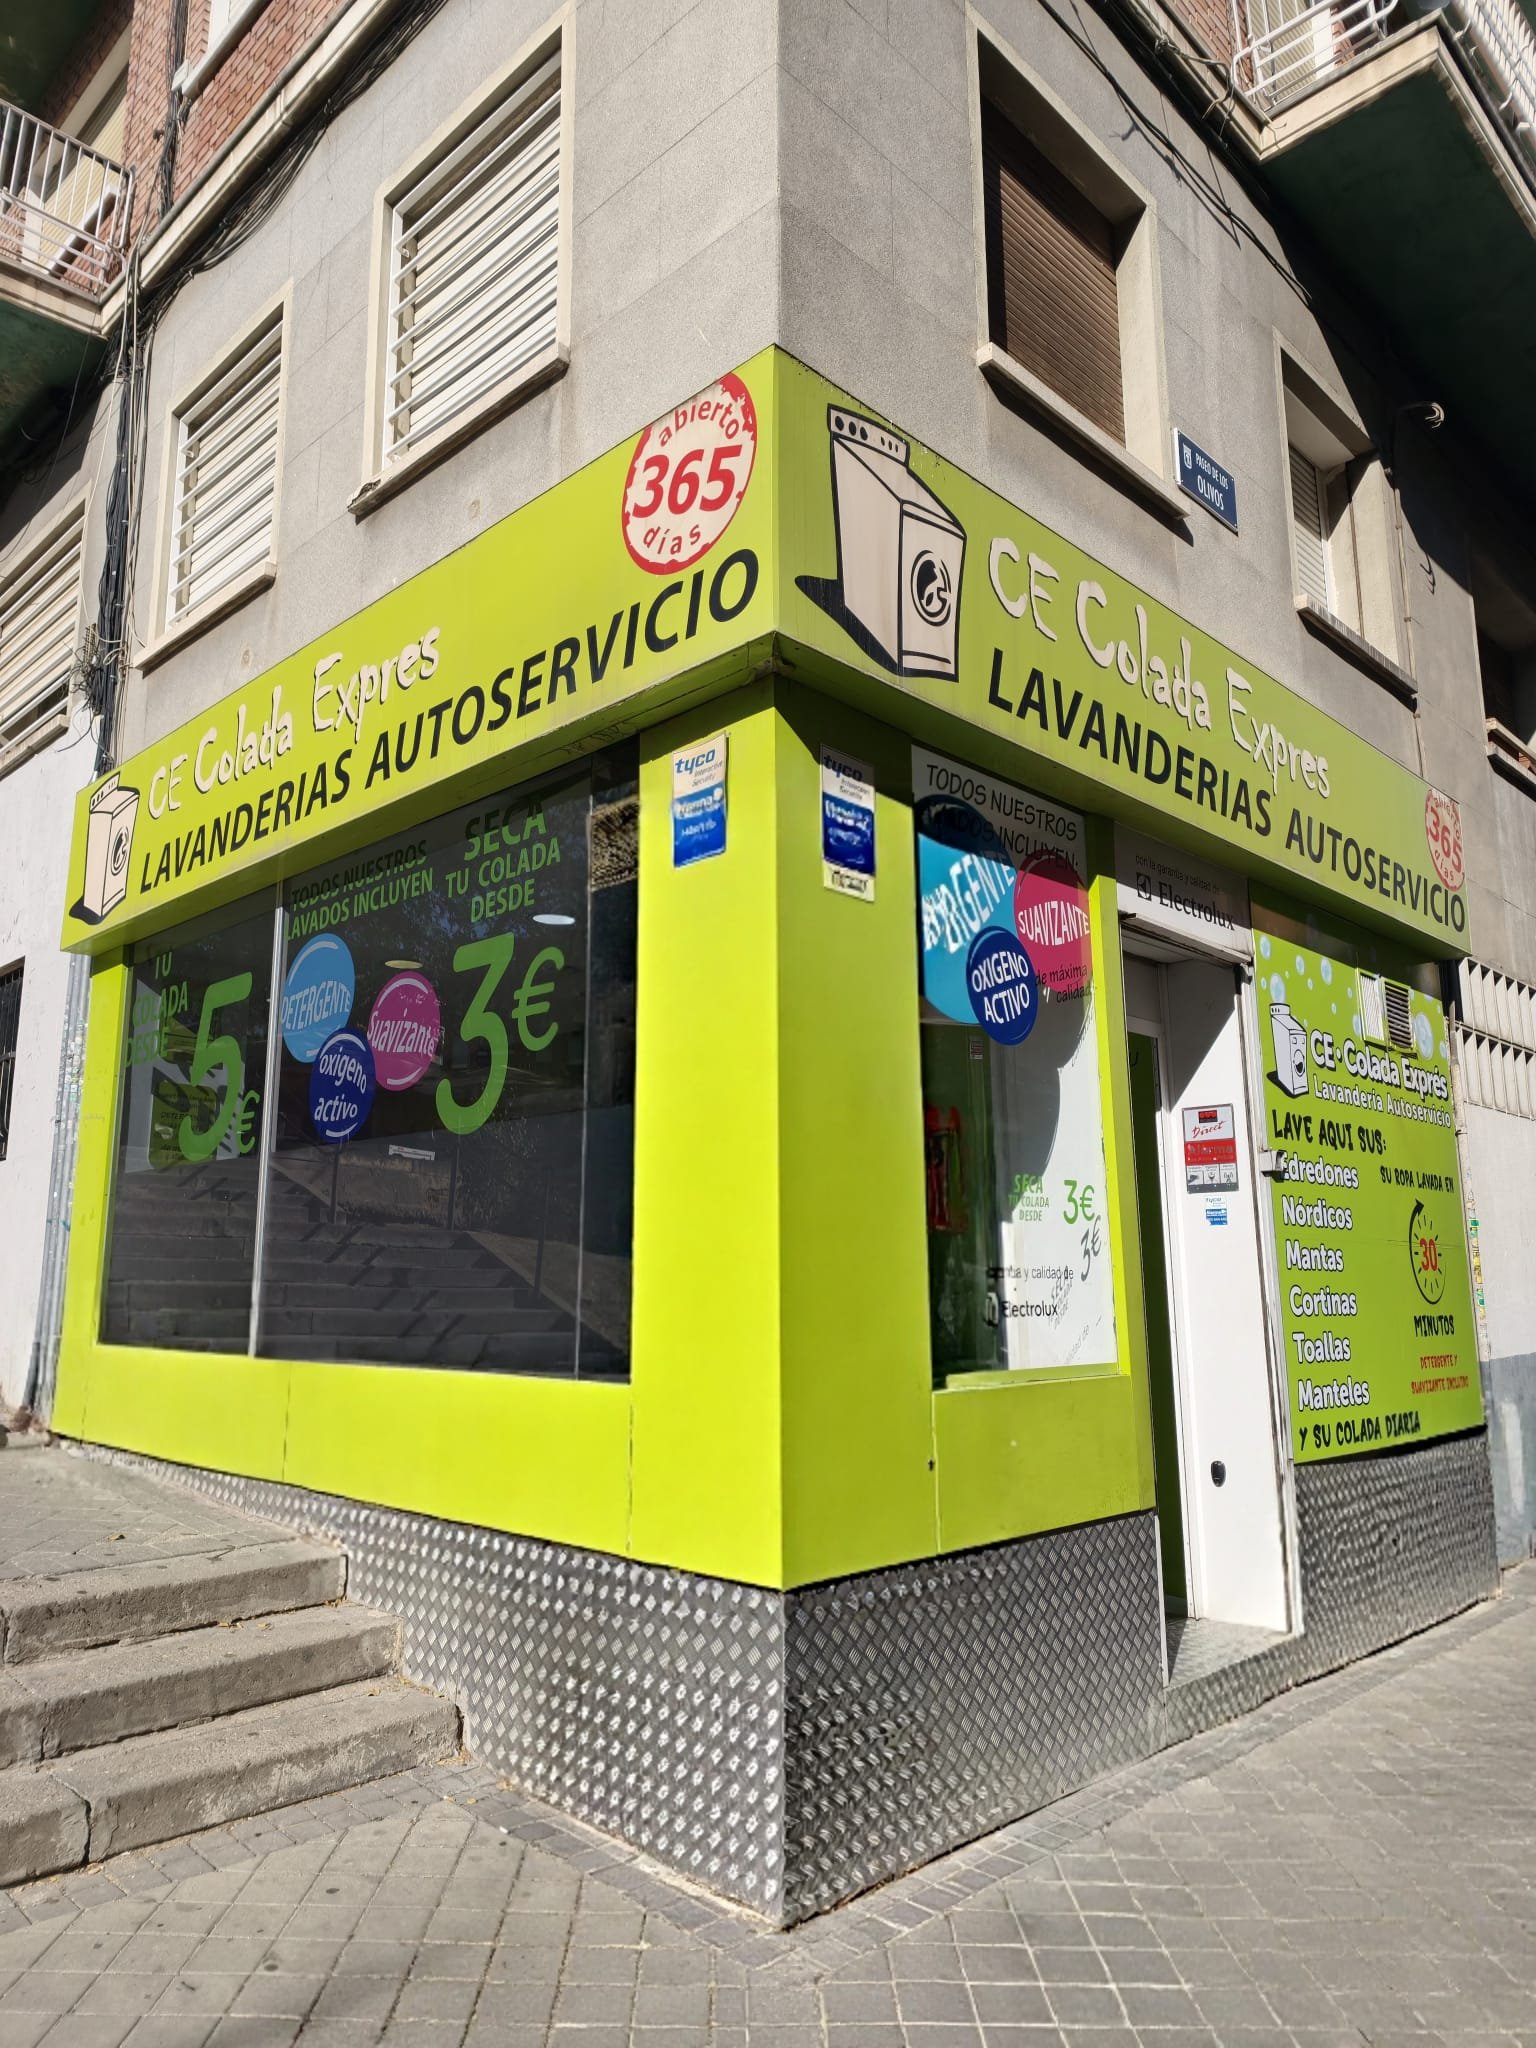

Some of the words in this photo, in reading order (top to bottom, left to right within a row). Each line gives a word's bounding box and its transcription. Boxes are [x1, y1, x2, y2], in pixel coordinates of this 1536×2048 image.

[658, 400, 740, 448] abierto
[632, 444, 742, 515] 365
[1195, 453, 1211, 475] PASEO
[1212, 464, 1219, 482] DE
[1219, 472, 1229, 489] LOS
[1197, 475, 1224, 511] OLIVOS
[642, 523, 701, 555] días
[988, 537, 1060, 642] CE
[1075, 580, 1211, 731] Colada
[140, 749, 353, 895] LAVANDERIAS
[365, 548, 759, 790] AUTOSERVICIO
[148, 754, 188, 820] CE
[194, 685, 292, 794] Colada
[675, 749, 716, 774] tyco
[823, 754, 864, 782] tyco
[926, 764, 987, 808] TODOS
[990, 788, 1078, 841] NUESTROS
[988, 647, 1272, 837] LAVANDERIAS
[1285, 808, 1465, 933] AUTOSERVICIO
[464, 799, 548, 861] SECA
[1429, 806, 1463, 873] 365
[291, 873, 340, 912] TODOS
[343, 839, 428, 893] NUESTROS
[446, 867, 470, 898] TU
[478, 836, 561, 887] COLADA
[284, 898, 350, 942] LAVADOS
[352, 866, 434, 919] INCLUYEN
[470, 878, 536, 924] DESDE
[1159, 881, 1235, 931] Electrolux
[1018, 901, 1091, 945] SUAVIZANTE
[971, 951, 1029, 993] OXIGENO
[281, 979, 351, 1032] DETERGENTE
[983, 983, 1030, 1024] ACTIVO
[366, 1007, 435, 1058] Suavizante
[314, 1093, 358, 1121] activo
[1386, 1093, 1452, 1129] Autoservicio
[1272, 1109, 1314, 1143] LAVE
[1319, 1118, 1354, 1151] AQUI
[1357, 1125, 1387, 1155] SUS:
[1013, 1174, 1044, 1194] SECA
[1282, 1151, 1359, 1189] Edredones
[1380, 1165, 1393, 1185] SU
[1395, 1167, 1414, 1187] ROPA
[1416, 1171, 1444, 1192] LAVADA
[1444, 1175, 1455, 1194] EN
[1018, 1209, 1043, 1222] DESDE
[1020, 1196, 1050, 1209] COLADA
[1063, 1179, 1096, 1225] 3€
[1281, 1195, 1353, 1230] Nórdicos
[1031, 1266, 1061, 1279] calidad
[1063, 1265, 1074, 1279] de
[1285, 1239, 1345, 1272] Mantas
[1419, 1238, 1439, 1271] 30
[1001, 1301, 1058, 1317] Electrolux
[1289, 1284, 1358, 1317] Cortinas
[1413, 1315, 1455, 1337] MINUTOS
[1292, 1331, 1352, 1364] Toallas
[1420, 1354, 1453, 1369] DETERGENTE
[1297, 1377, 1370, 1412] Manteles
[1299, 1429, 1308, 1452] Y
[1313, 1423, 1331, 1449] SU
[1336, 1418, 1381, 1446] COLADA
[1384, 1411, 1421, 1440] DIARIA
